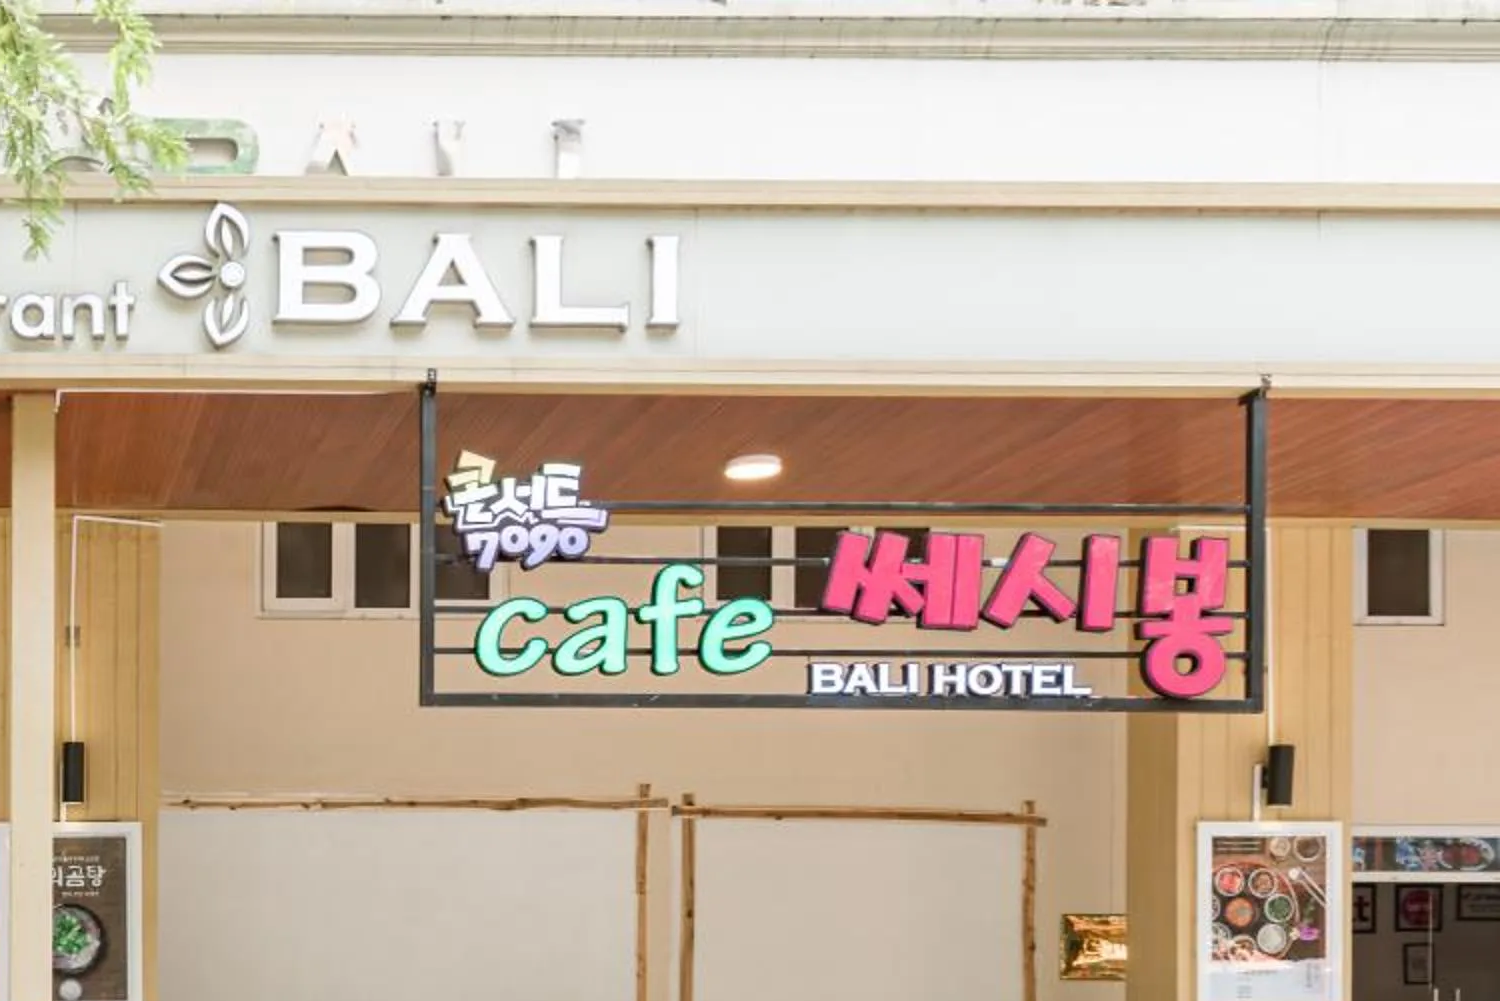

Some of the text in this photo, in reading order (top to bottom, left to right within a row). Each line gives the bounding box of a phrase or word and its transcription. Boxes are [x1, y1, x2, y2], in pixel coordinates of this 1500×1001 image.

[272, 230, 680, 332] BALI
[444, 449, 609, 532] 콘서트
[464, 523, 591, 571] 7090
[475, 563, 775, 676] cafe
[820, 531, 1235, 699] 쎄시봉
[807, 662, 1094, 697] BALI HOTEL
